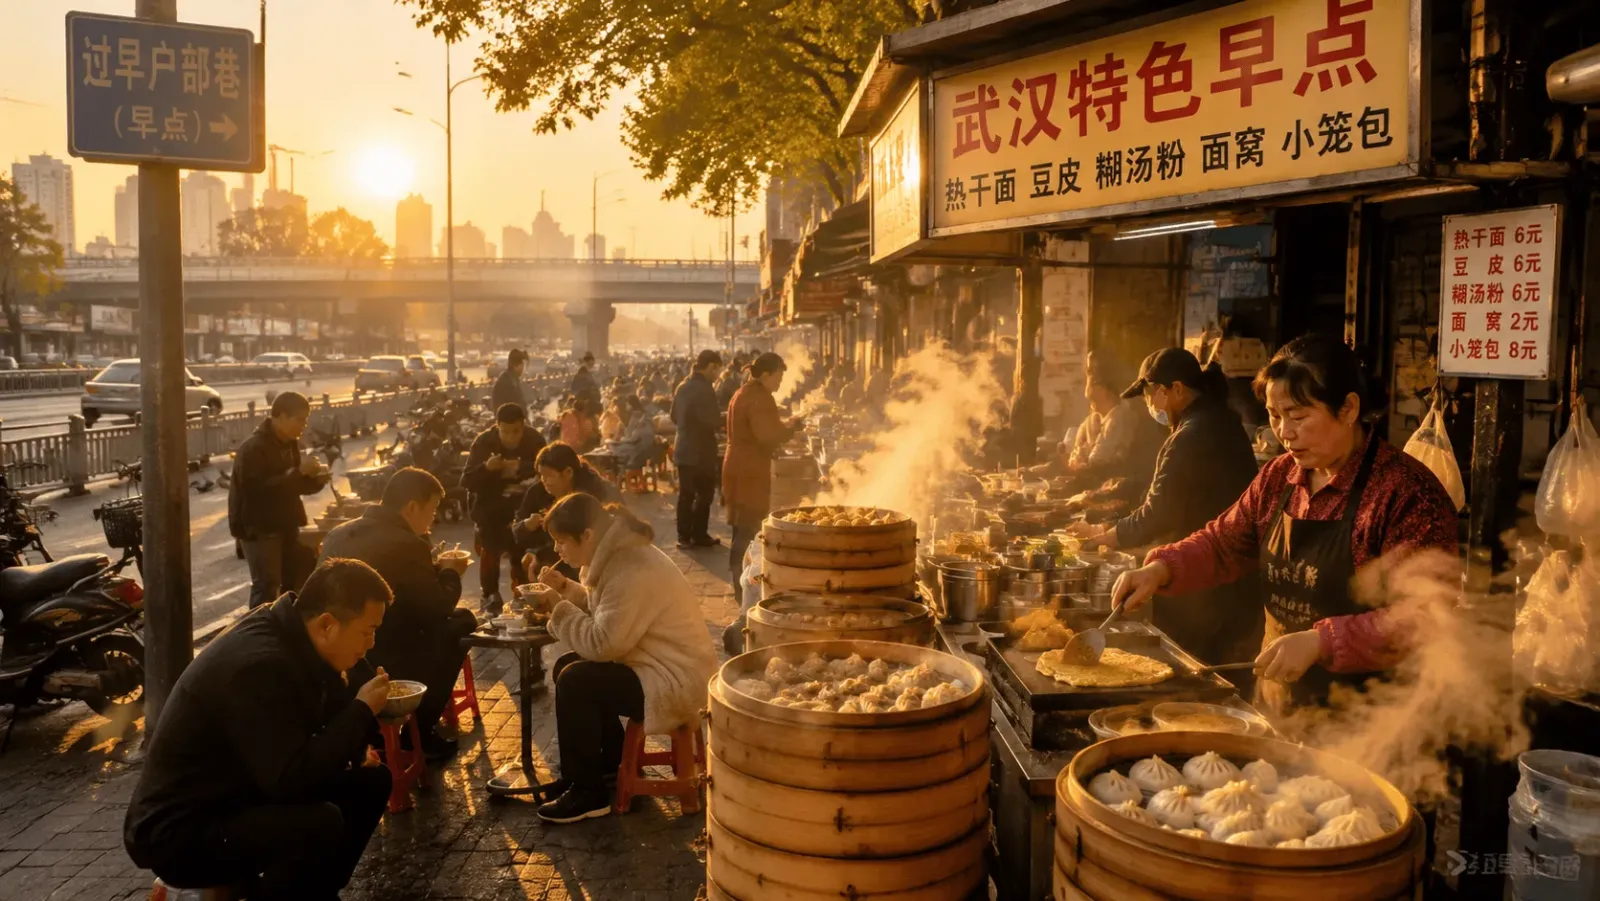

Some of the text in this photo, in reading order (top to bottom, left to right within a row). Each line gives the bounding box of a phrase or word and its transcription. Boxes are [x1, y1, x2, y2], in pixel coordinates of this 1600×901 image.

[82, 35, 240, 99] 过早户部巷
[953, 0, 1377, 159] 武汉特色早点
[945, 106, 1393, 212] 热干面 豆皮 糊汤粉 面窝 小笼包
[1454, 224, 1543, 250] 热干面 6元
[1513, 253, 1541, 273] 6元
[1452, 281, 1540, 304] 糊汤粉 6元
[1510, 311, 1539, 331] 2元
[1450, 338, 1537, 360] 小笼包 8元
